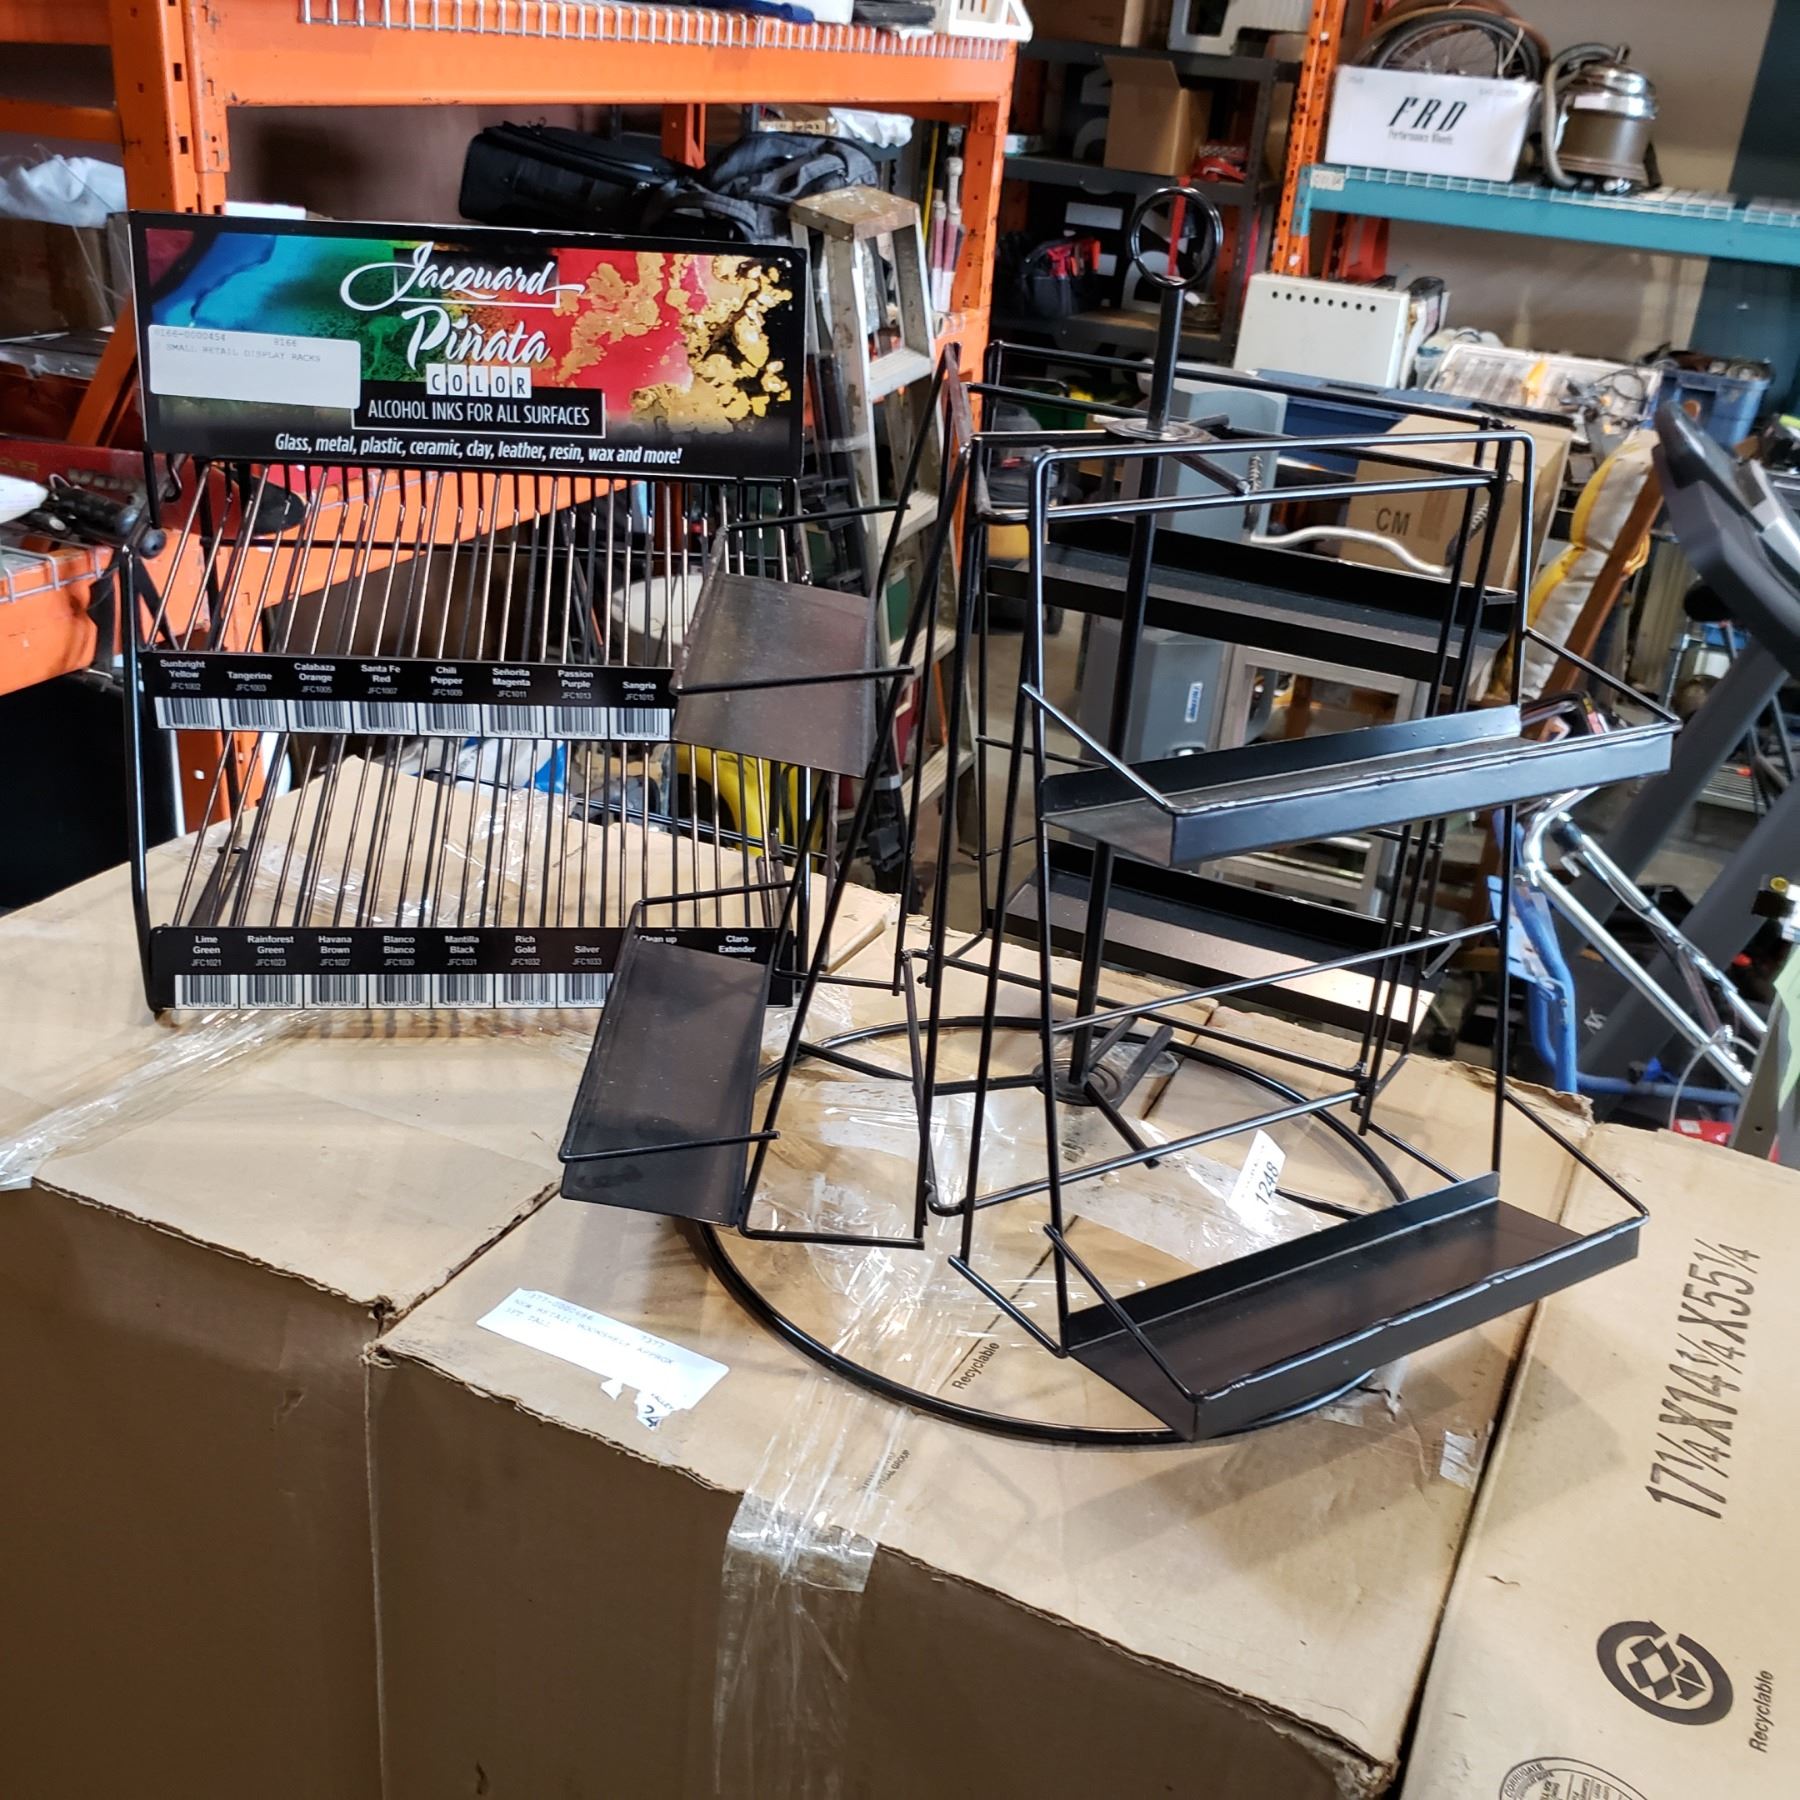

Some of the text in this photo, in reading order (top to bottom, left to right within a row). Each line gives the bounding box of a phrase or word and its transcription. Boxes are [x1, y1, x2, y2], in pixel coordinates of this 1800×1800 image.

[1387, 96, 1468, 132] FRD
[340, 241, 586, 311] Jacquard
[401, 305, 551, 371] Piñata
[430, 372, 527, 396] COLOR
[368, 400, 590, 426] ALCOHOL INKS FOR ALL SURFACES
[275, 433, 682, 465] Glass, metal, plastic, ceramic, clay, leather, resin, wax and more!
[1377, 507, 1411, 537] CM
[160, 659, 205, 669] Sunbright
[294, 663, 336, 672] Calabaza
[360, 664, 401, 673] Santa Fe
[168, 670, 200, 679] Yellow
[435, 666, 457, 675] Chili
[558, 669, 594, 678] Passion
[227, 671, 273, 681] Tangerine
[298, 673, 333, 683] Orange
[372, 675, 391, 683] Red
[430, 676, 463, 686] Pepper
[492, 678, 531, 688] Magenta
[561, 680, 591, 689] Purple
[622, 681, 657, 691] Sangria
[195, 935, 218, 943] Lime
[247, 935, 295, 943] Rainforest
[318, 935, 352, 943] Havana
[383, 935, 416, 943] Blanco
[444, 935, 480, 943] Mantilla
[515, 935, 536, 943] Rich
[665, 936, 678, 945] up
[725, 934, 750, 943] Claro
[192, 946, 221, 954] Green
[257, 946, 285, 954] Green
[320, 946, 350, 954] Brown
[383, 946, 416, 954] Blanco
[450, 946, 475, 954] Black
[515, 946, 537, 954] Gold
[574, 945, 601, 953] Silver
[718, 945, 757, 953] Extender
[1255, 1161, 1279, 1206] 1248
[951, 1341, 1001, 1390] Recyclable
[1748, 1669, 1774, 1754] Recyclable
